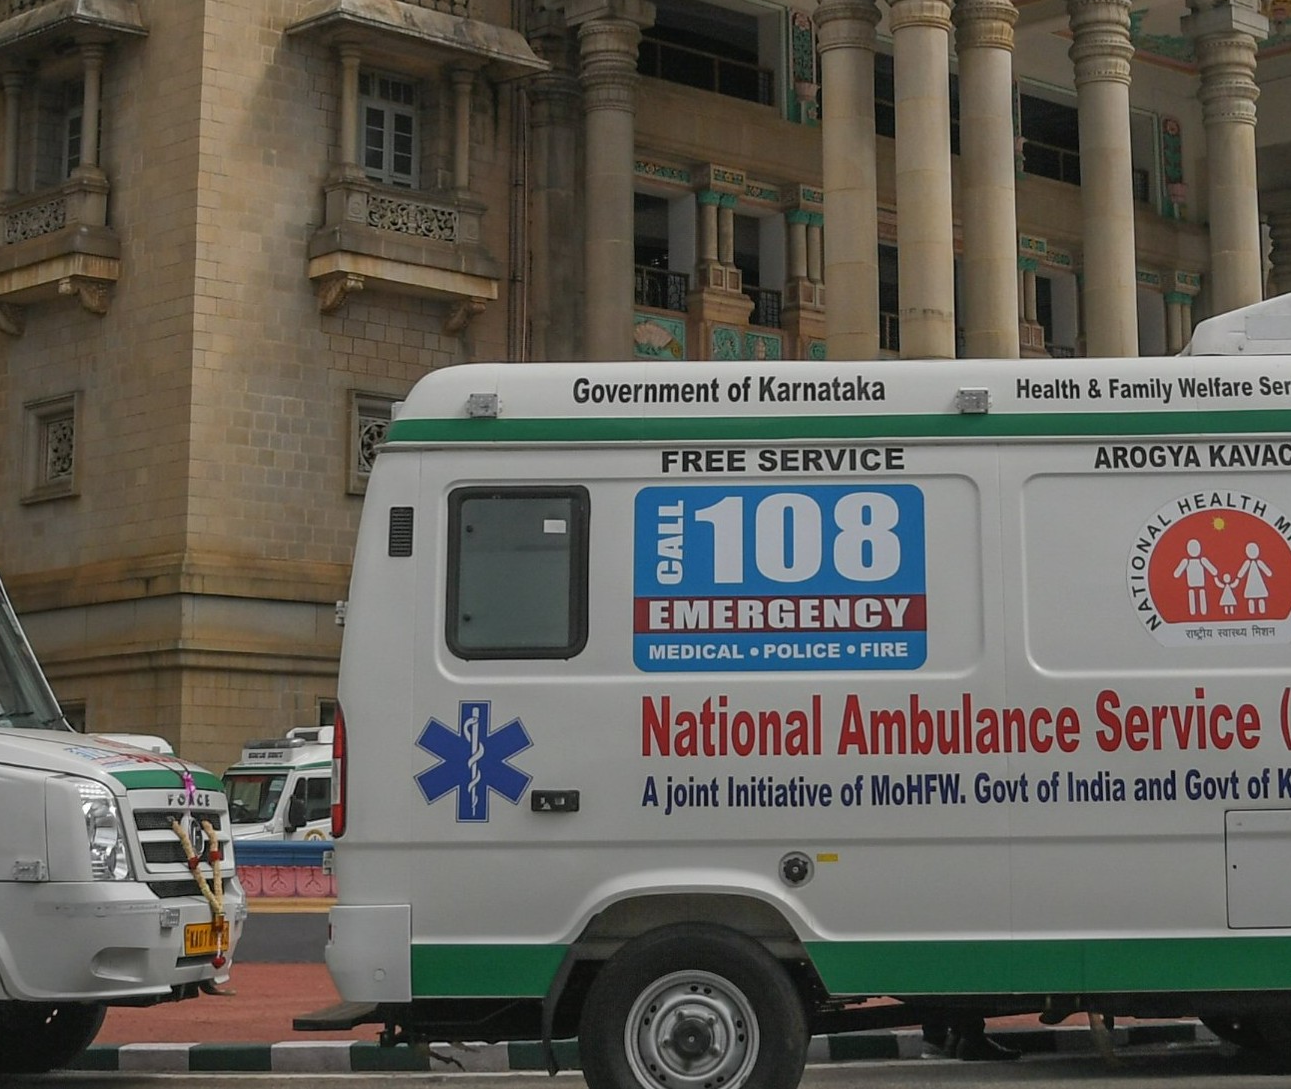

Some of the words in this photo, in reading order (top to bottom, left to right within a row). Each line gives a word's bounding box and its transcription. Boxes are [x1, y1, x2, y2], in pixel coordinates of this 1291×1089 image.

[573, 377, 720, 403] Government
[727, 376, 751, 402] of
[759, 375, 886, 402] Karnataka
[1016, 377, 1080, 400] Health
[1087, 378, 1102, 399] &
[1109, 377, 1173, 403] Family
[1177, 376, 1253, 398] Welfare
[661, 449, 747, 473] FREE
[758, 447, 905, 472] SERVICE
[1094, 445, 1200, 469] AROGYA
[656, 499, 684, 585] CALL
[694, 491, 901, 584] 108
[1132, 513, 1172, 632] NATIONAL
[1177, 492, 1268, 517] HEALTH
[648, 598, 910, 630] EMERGENCY
[649, 643, 744, 660] MEDICAL
[764, 642, 841, 659] POLICE
[861, 642, 908, 658] FIRE
[641, 694, 821, 757] National
[837, 693, 1080, 755] Ambulance
[1095, 687, 1261, 753] Service
[641, 776, 659, 807] A
[664, 776, 719, 816] joint
[727, 775, 833, 808] Initiative
[840, 775, 864, 807] of
[871, 773, 966, 806] MoHFW.
[974, 772, 1028, 805] Govt
[1037, 771, 1060, 803] of
[1068, 771, 1126, 803] India
[1134, 770, 1177, 801] and
[1185, 769, 1239, 801] Govt
[1247, 768, 1270, 800] of
